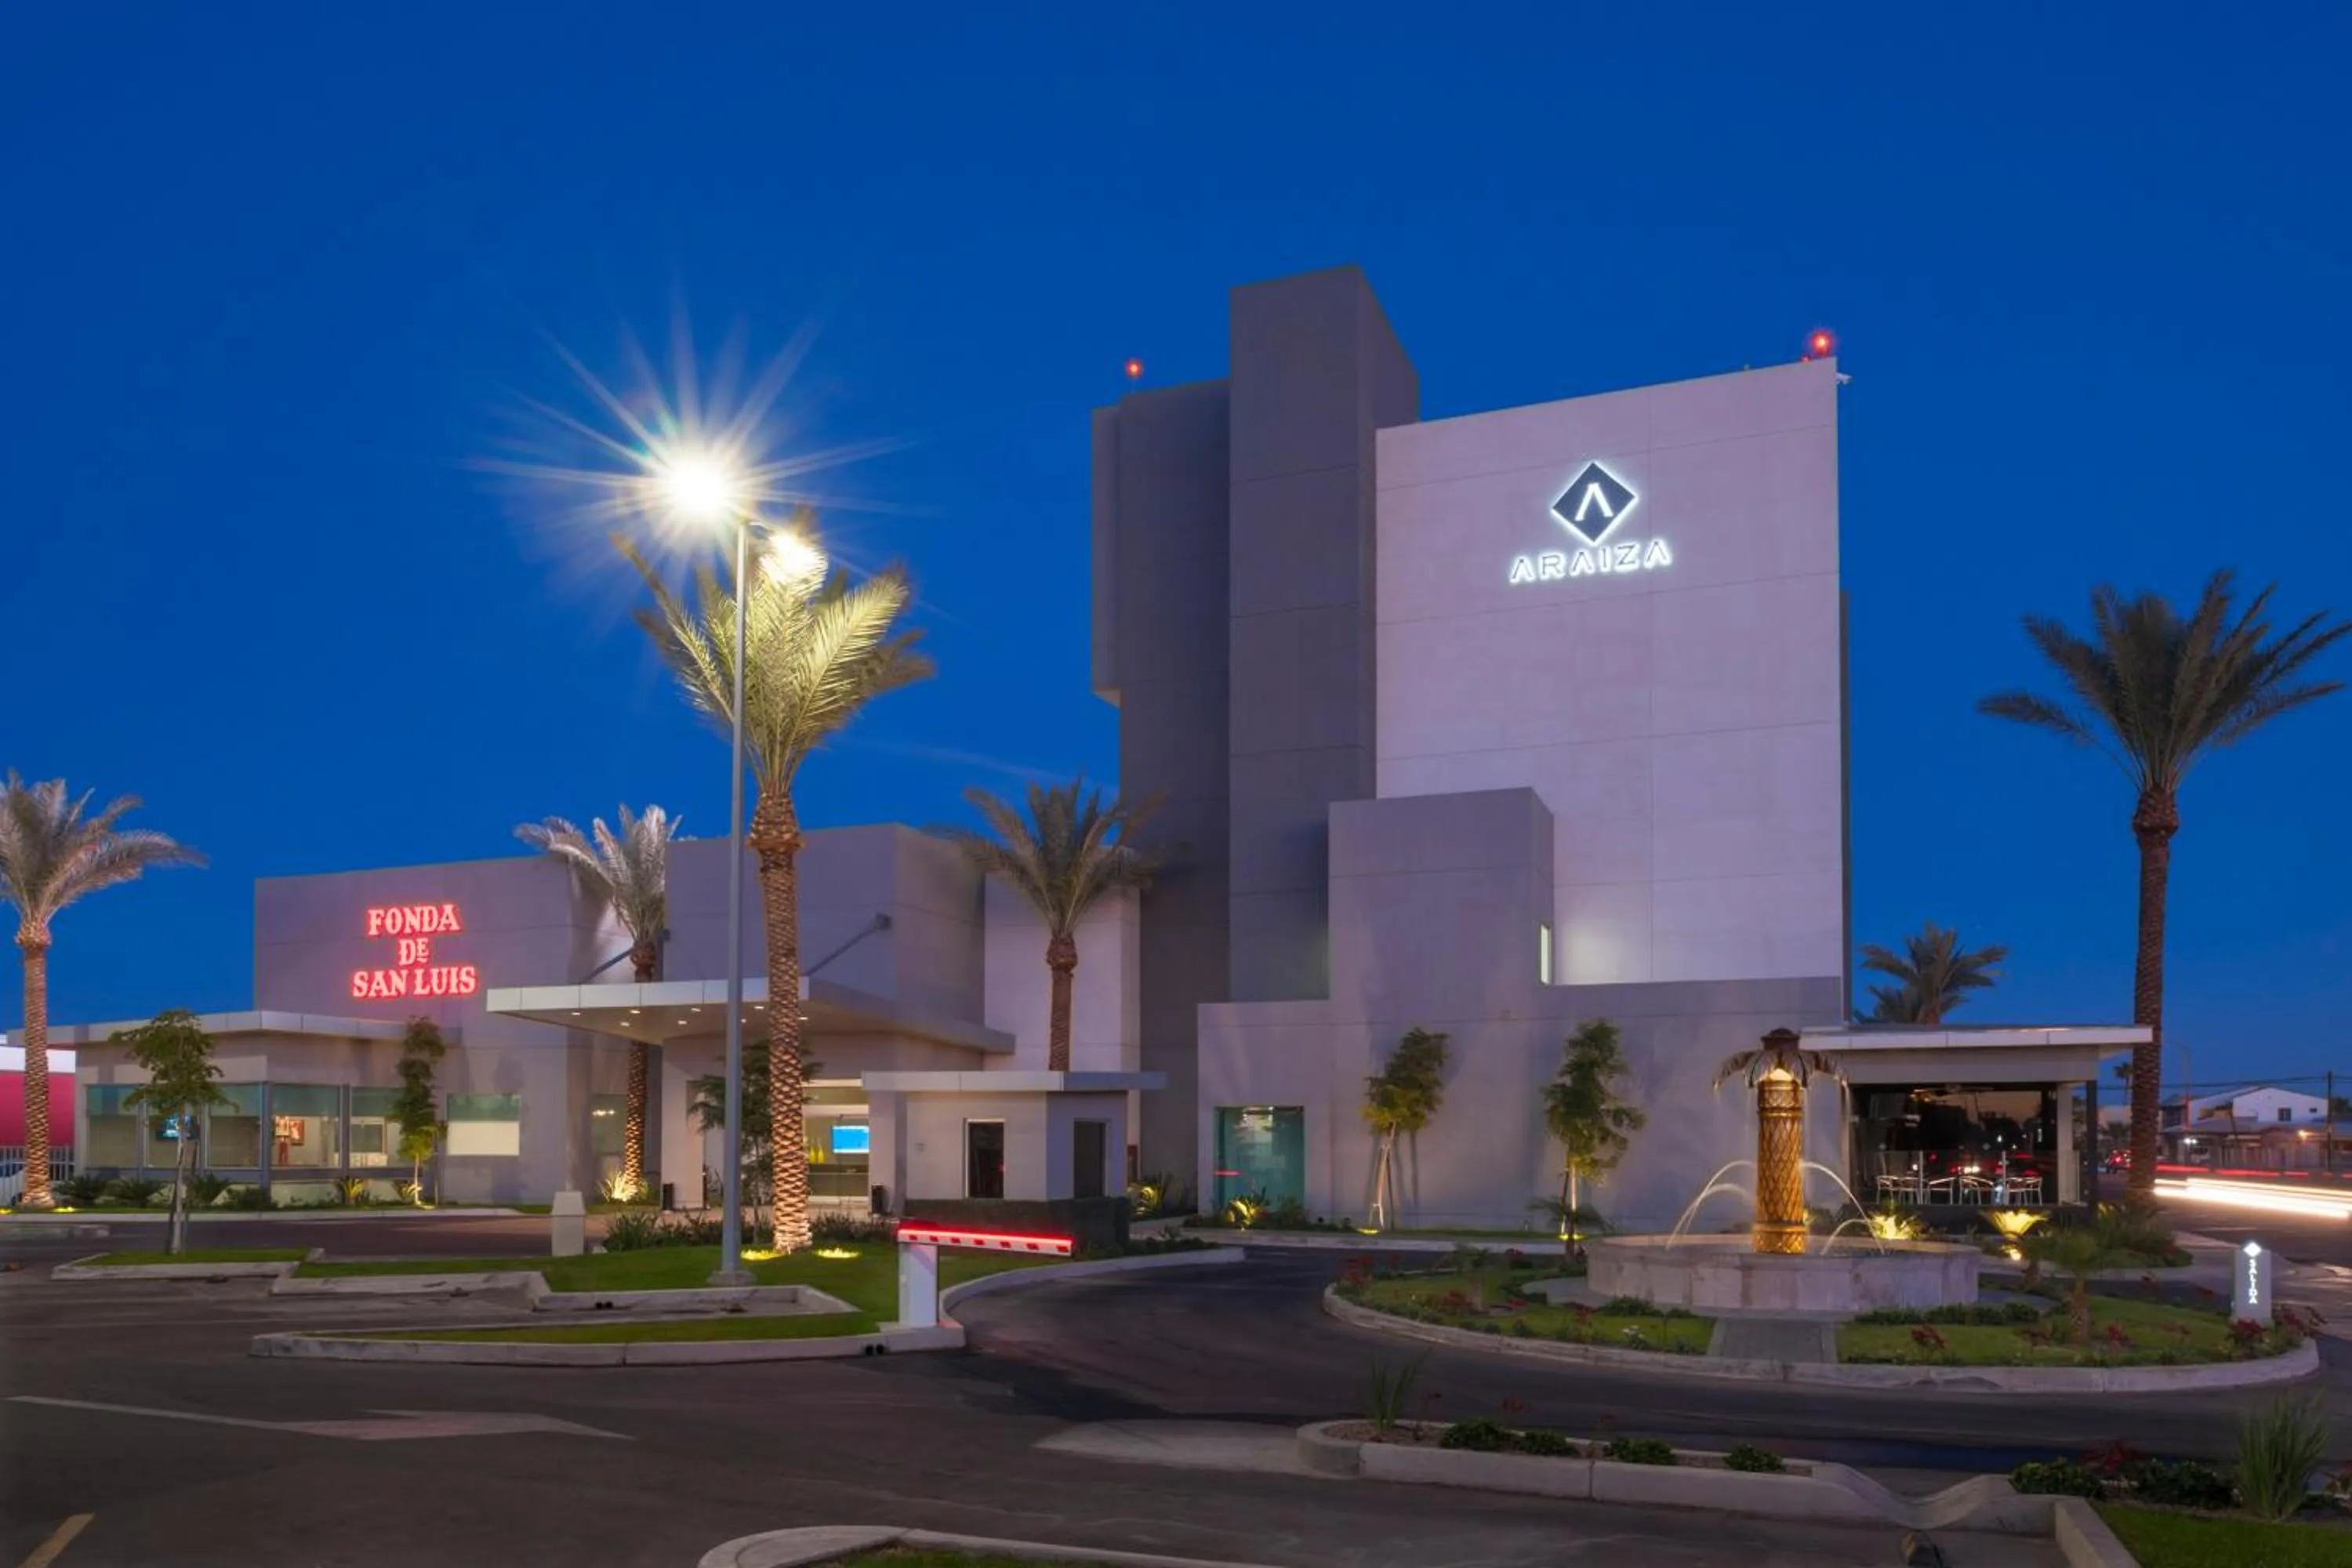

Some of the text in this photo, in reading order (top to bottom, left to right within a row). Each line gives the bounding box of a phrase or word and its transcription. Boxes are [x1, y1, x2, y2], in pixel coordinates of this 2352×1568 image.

[1509, 539, 1671, 583] ARAIZA
[368, 904, 460, 935] FONDA
[398, 937, 430, 966] DE
[353, 966, 476, 997] SAN LUIS
[2248, 1258, 2258, 1305] SALIDA
